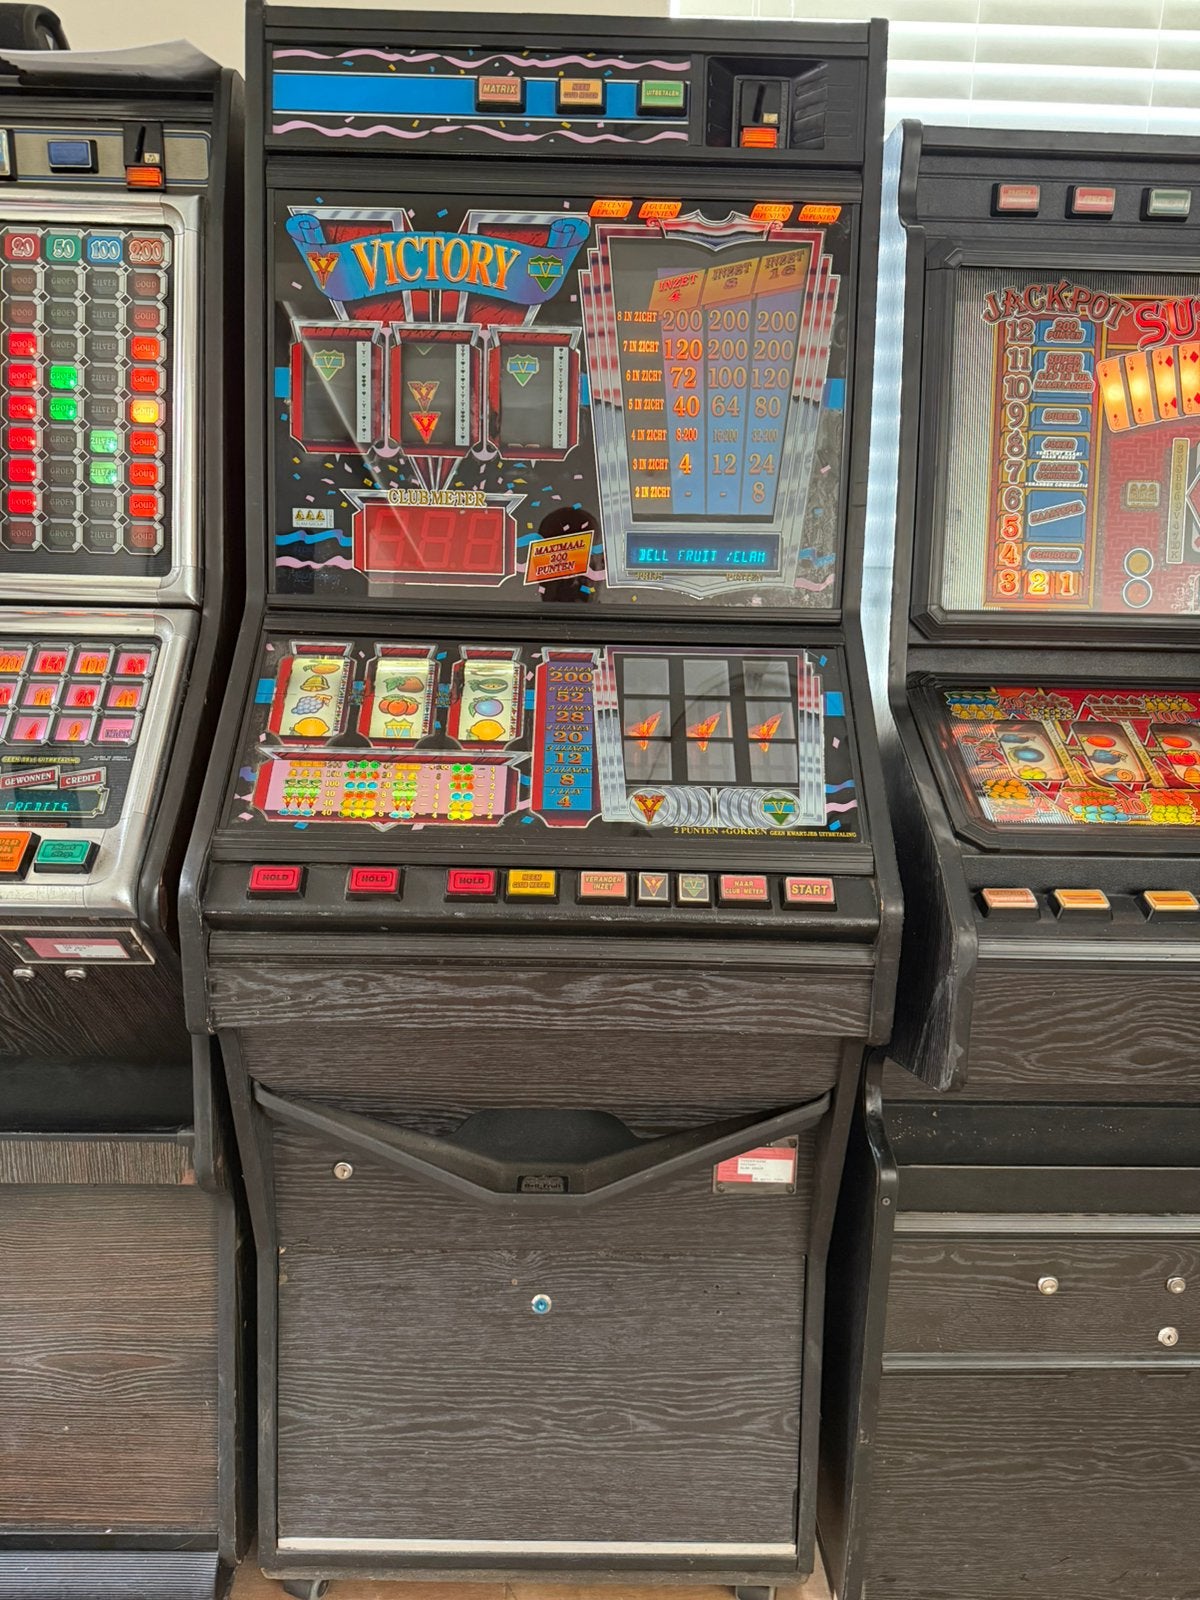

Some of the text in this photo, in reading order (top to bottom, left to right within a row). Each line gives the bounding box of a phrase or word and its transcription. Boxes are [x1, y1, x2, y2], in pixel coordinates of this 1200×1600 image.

[481, 83, 518, 95] MATRIX
[646, 89, 680, 97] UITBETALEN
[12, 237, 35, 257] 20
[52, 239, 75, 259] 50
[90, 240, 121, 259] 100
[128, 240, 165, 263] 200
[351, 235, 522, 291] VICTORY
[764, 250, 805, 269] INZET
[712, 263, 752, 280] INZET
[770, 264, 797, 280] 16
[658, 274, 698, 292] INZET
[135, 313, 156, 321] GOUD
[617, 311, 657, 322] 8 IN ZICHT
[662, 309, 703, 331] 200
[709, 309, 749, 331] 200
[757, 310, 797, 332] 200
[981, 279, 1200, 351] JACKPOT SU
[1007, 319, 1034, 343] 12
[1055, 320, 1078, 331] 200
[1047, 330, 1083, 340] PUNTEN
[623, 339, 660, 353] 7 IN ZICHT
[664, 338, 703, 361] 120
[707, 338, 748, 361] 200
[753, 339, 794, 361] 200
[1008, 348, 1031, 371] 11
[1047, 354, 1081, 363] SUPER
[625, 370, 663, 382] 6 IN ZICHT
[670, 366, 697, 388] 72
[1046, 363, 1081, 373] FLUSH
[708, 366, 748, 389] 100
[752, 367, 790, 389] 120
[1004, 376, 1031, 399] 10
[628, 398, 665, 410] 5 IN ZICHT
[673, 395, 700, 417] 40
[711, 395, 740, 417] 64
[754, 396, 781, 418] 80
[1007, 402, 1026, 428] 9
[51, 435, 75, 443] GROEN
[631, 429, 667, 441] 4 IN ZICHT
[1006, 430, 1026, 458] 8
[51, 467, 75, 475] GROEN
[632, 458, 669, 471] 3 IN ZICHT
[678, 453, 692, 475] 4
[712, 453, 737, 475] 12
[749, 453, 775, 475] 24
[1005, 459, 1025, 484] 7
[388, 489, 487, 507] CLUB METER
[635, 486, 671, 498] 2 IN ZICHT
[752, 482, 766, 503] 8
[1003, 486, 1023, 512] 6
[1001, 513, 1021, 540] 5
[534, 538, 586, 557] MAXIMAAL
[677, 549, 718, 563] FRUIT
[1000, 541, 1019, 567] 4
[550, 552, 568, 563] 200
[535, 561, 575, 576] PUNTEN
[999, 569, 1019, 595] 3
[1029, 569, 1048, 595] 2
[1060, 571, 1074, 595] 1
[549, 672, 594, 683] 200
[556, 691, 584, 703] 52
[555, 711, 584, 723] 28
[26, 721, 40, 739] 4
[553, 731, 583, 743] 20
[555, 752, 582, 764] 12
[4, 771, 52, 786] GEWONNEN
[65, 773, 97, 785] CREDIT
[560, 773, 575, 786] 8
[557, 795, 571, 808] 4
[681, 827, 719, 835] PUNTEN
[262, 873, 289, 882] HOLD
[361, 875, 388, 883] HOLD
[459, 877, 485, 885] HOLD
[585, 875, 623, 883] VERANDER
[791, 884, 828, 895] START
